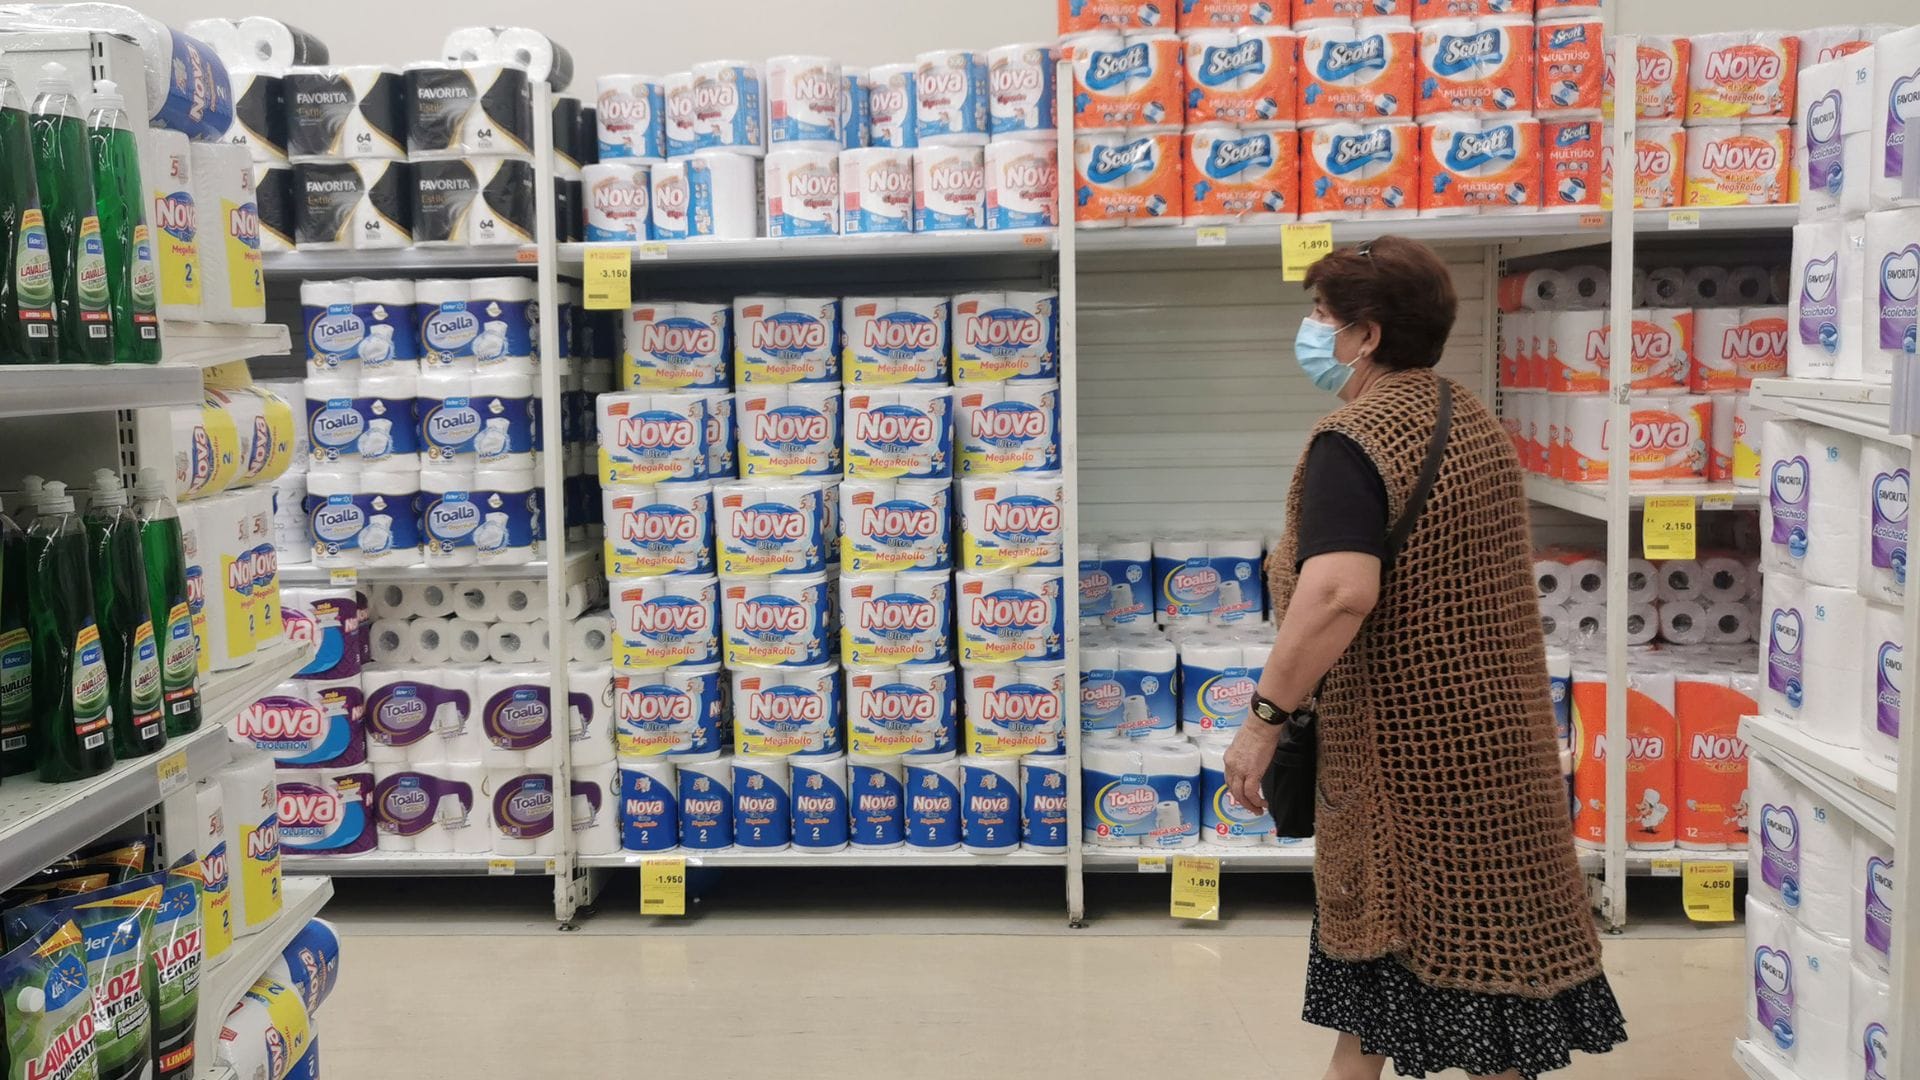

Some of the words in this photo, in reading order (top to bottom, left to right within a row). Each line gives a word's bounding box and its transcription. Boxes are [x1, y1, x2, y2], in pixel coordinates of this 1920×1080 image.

[1554, 25, 1584, 44] Scott
[1329, 42, 1376, 70] Scott
[1445, 35, 1492, 62] Scott
[1096, 48, 1143, 79] Scott
[1209, 43, 1255, 75] Scott
[1543, 52, 1590, 63] MULTIUSO
[1705, 51, 1780, 80] Nova
[1856, 68, 1866, 80] 16
[186, 42, 206, 123] Nova
[297, 93, 347, 104] FAVORITA
[418, 88, 468, 98] FAVORITA
[1445, 88, 1490, 98] MULTIUSO
[1719, 93, 1765, 103] MegaRollo
[1896, 90, 1920, 105] FAVORI
[1210, 99, 1252, 107] MULTIUSO
[1812, 111, 1834, 126] FAVORITA
[357, 132, 371, 143] 64
[478, 128, 492, 138] 64
[1560, 126, 1588, 142] Scott
[1214, 138, 1264, 167] Scott
[1338, 134, 1385, 163] Scott
[1456, 131, 1507, 161] Scott
[1550, 150, 1594, 159] MULTIUSO
[1703, 143, 1776, 170] Nova
[932, 167, 984, 190] Nova
[1006, 165, 1057, 187] Nova
[306, 180, 356, 192] FAVORITA
[1338, 186, 1380, 195] MULTIUSO
[1457, 182, 1503, 192] MULTIUSO
[1716, 183, 1761, 193] MegaRollo
[594, 187, 646, 208] Nova
[1217, 191, 1261, 200] MULTIUSO
[365, 220, 380, 230] 64
[185, 263, 192, 281] 2
[1887, 269, 1916, 279] FAVORITA
[318, 320, 360, 337] Toalla
[432, 316, 473, 335] Toalla
[864, 319, 937, 348] Nova
[966, 317, 1041, 344] Nova
[643, 324, 716, 353] Nova
[753, 321, 825, 349] Nova
[442, 353, 452, 362] 25
[980, 360, 1029, 369] MegaRollo
[656, 368, 703, 378] MegaRollo
[766, 364, 814, 374] MegaRollo
[855, 370, 862, 381] 2
[878, 363, 925, 373] MegaRollo
[959, 368, 965, 379] 2
[634, 374, 640, 385] 2
[745, 371, 751, 382] 2
[318, 415, 358, 431] Toalla
[434, 413, 476, 430] Toalla
[755, 414, 828, 442] Nova
[857, 412, 932, 441] Nova
[971, 409, 1046, 437] Nova
[618, 419, 693, 447] Nova
[443, 448, 453, 457] 25
[986, 453, 1033, 462] MegaRollo
[1827, 447, 1838, 458] 16
[632, 462, 681, 473] MegaRollo
[769, 456, 817, 466] MegaRollo
[870, 458, 919, 468] MegaRollo
[1777, 475, 1801, 485] FAVORITA
[1879, 490, 1906, 503] FAVORITA
[320, 511, 359, 527] Toalla
[434, 508, 475, 523] Toalla
[862, 508, 937, 536] Nova
[985, 504, 1060, 532] Nova
[623, 512, 697, 540] Nova
[732, 510, 805, 539] Nova
[636, 555, 685, 565] MegaRollo
[746, 554, 794, 564] MegaRollo
[876, 551, 925, 562] MegaRollo
[999, 548, 1048, 558] MegaRollo
[1175, 572, 1216, 589] Toalla
[265, 604, 271, 619] 2
[632, 604, 706, 632] Nova
[736, 603, 806, 630] Nova
[861, 600, 935, 629] Nova
[972, 597, 1046, 625] Nova
[1815, 605, 1825, 618] 16
[1776, 623, 1797, 637] FAVORITA
[1210, 682, 1255, 699] Toalla
[385, 701, 422, 718] Toalla
[620, 692, 692, 720] Nova
[750, 692, 822, 720] Nova
[861, 691, 935, 719] Nova
[984, 691, 1058, 720] Nova
[1097, 696, 1122, 708] Super
[237, 703, 321, 736] Nova
[505, 704, 543, 721] Toalla
[256, 741, 308, 750] EVOLUTION
[391, 791, 425, 807] Toalla
[514, 794, 551, 810] Toalla
[739, 796, 776, 812] Nova
[798, 796, 835, 811] Nova
[860, 794, 897, 811] Nova
[913, 795, 950, 811] Nova
[971, 795, 1009, 811] Nova
[1108, 790, 1154, 806] Toalla
[277, 794, 336, 825] ova
[626, 799, 664, 816] Nova
[685, 799, 723, 815] Nova
[1128, 804, 1155, 815] Super
[1813, 807, 1826, 820] 16
[279, 828, 323, 837] OLUTION
[1113, 826, 1124, 834] 32
[1590, 827, 1601, 836] 12
[1686, 828, 1698, 837] 12
[1767, 818, 1792, 836] FAVORITA
[272, 878, 277, 893] 2
[223, 910, 229, 928] 2
[1762, 960, 1784, 981] FAVORITA
[1807, 955, 1818, 970] 16
[300, 947, 319, 1016] Nova
[28, 1013, 95, 1080] LAVALO
[167, 1046, 193, 1067] LIMÓN
